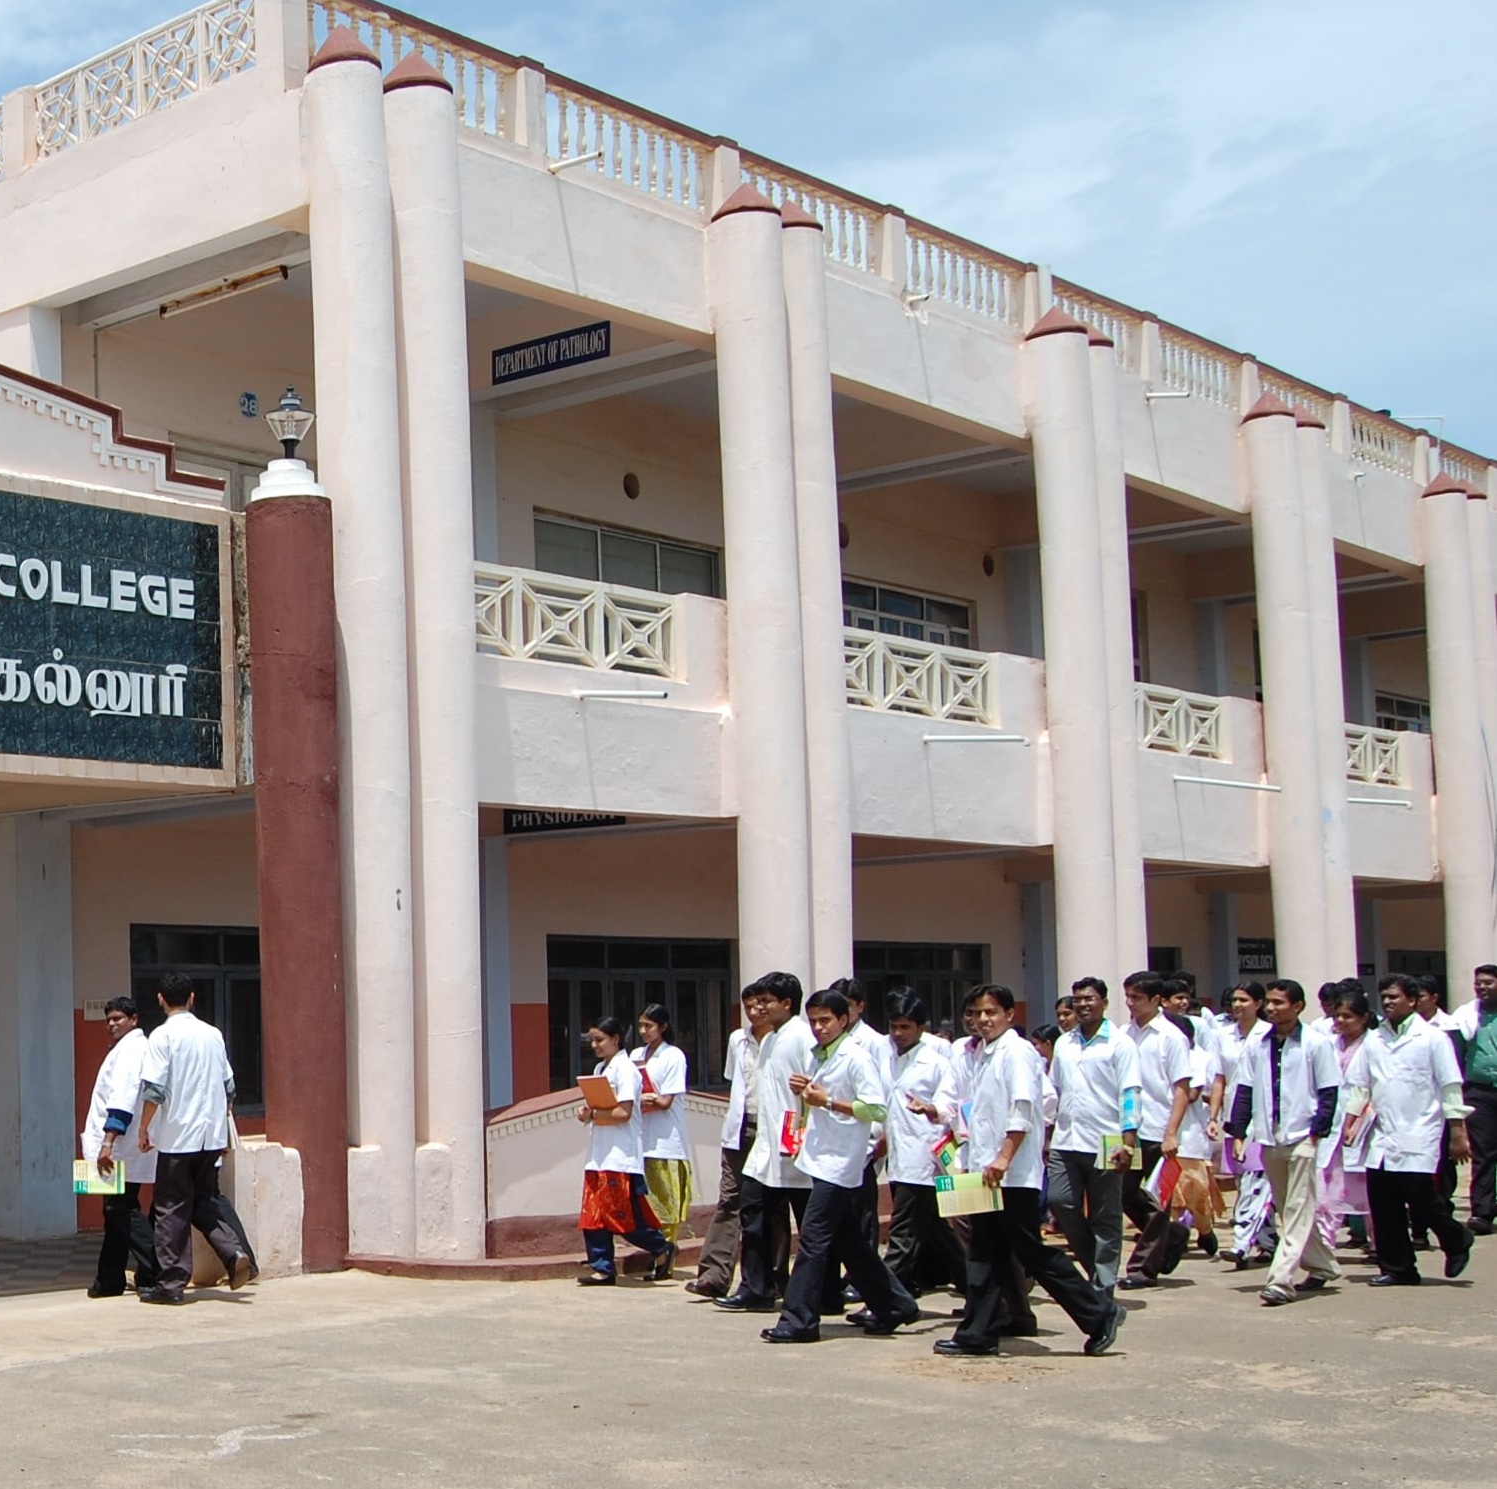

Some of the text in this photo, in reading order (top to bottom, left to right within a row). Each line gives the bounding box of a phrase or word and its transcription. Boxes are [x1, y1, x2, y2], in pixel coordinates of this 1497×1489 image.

[495, 328, 607, 378] DEPARTMENT OF PATHOLOGY
[240, 396, 258, 414] 28
